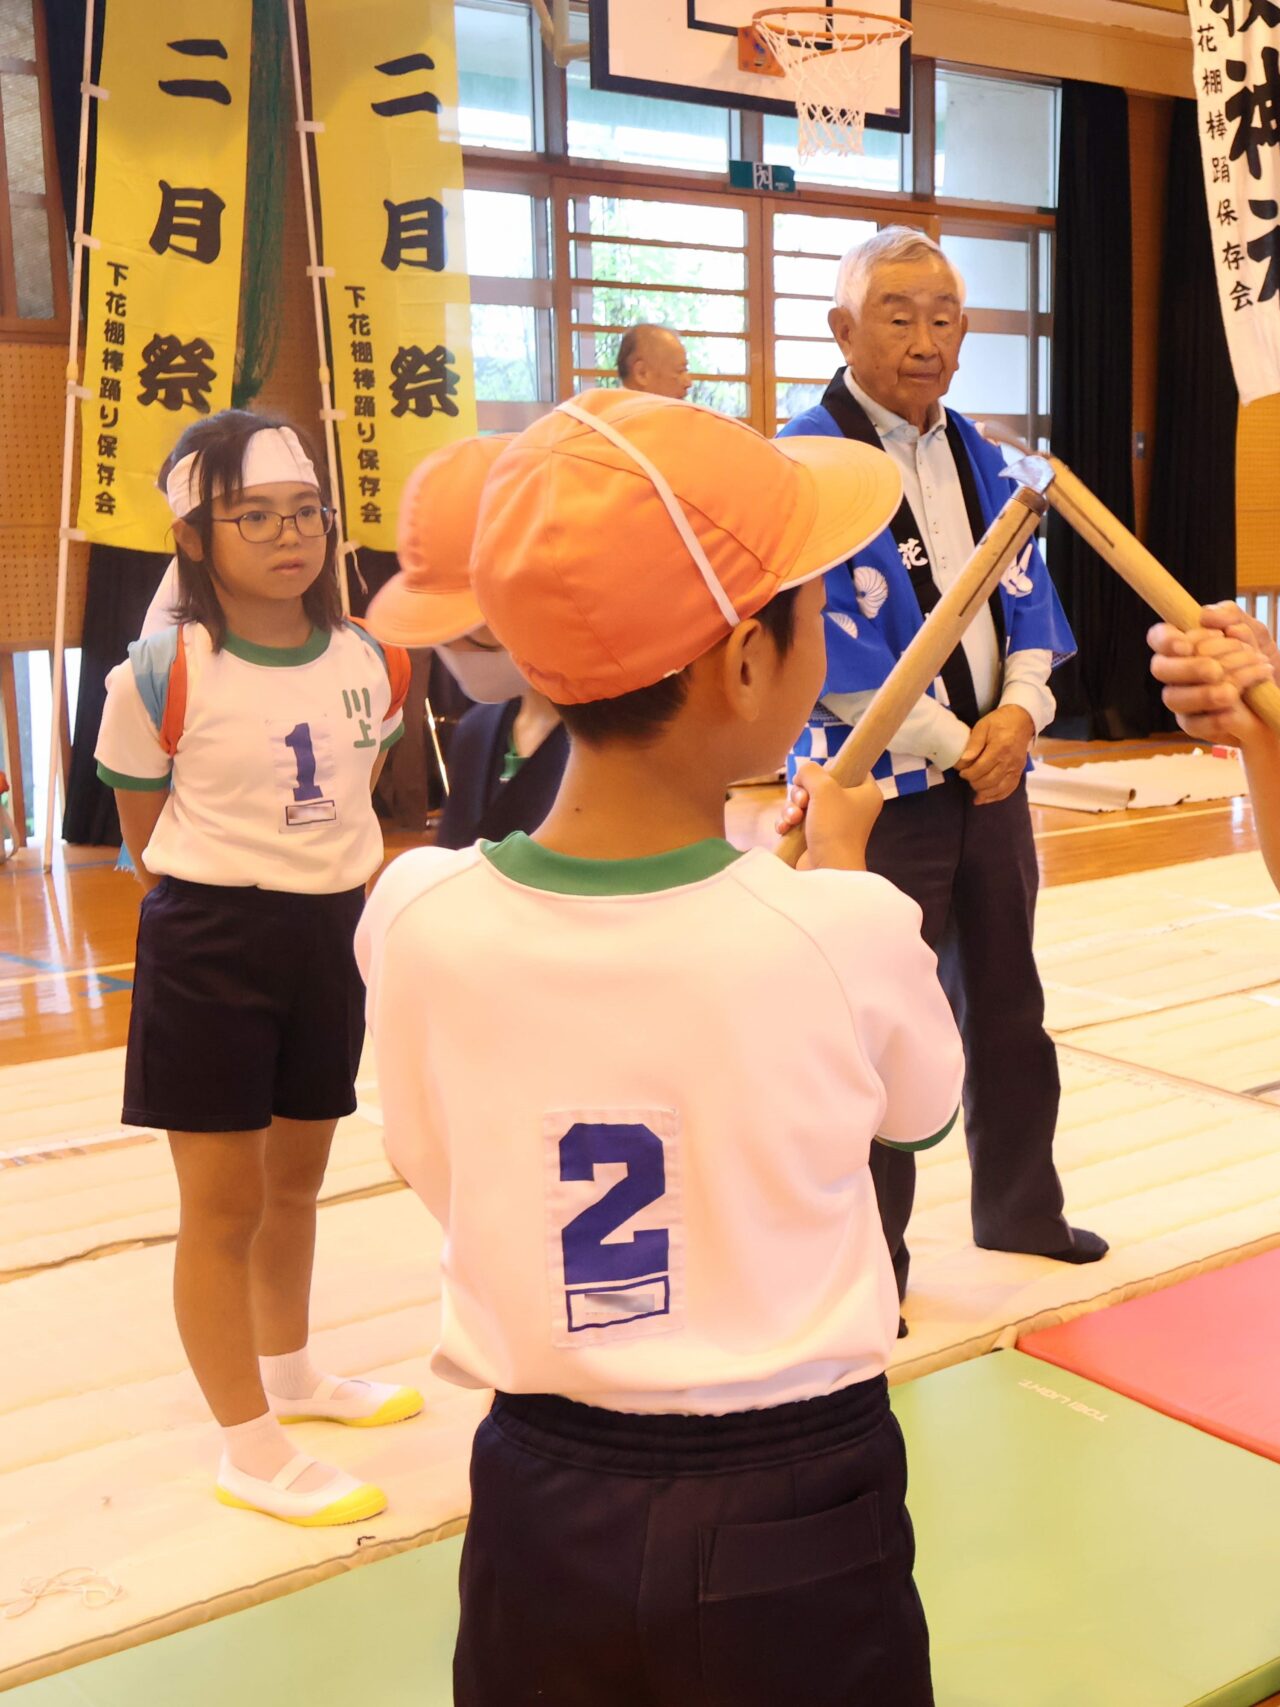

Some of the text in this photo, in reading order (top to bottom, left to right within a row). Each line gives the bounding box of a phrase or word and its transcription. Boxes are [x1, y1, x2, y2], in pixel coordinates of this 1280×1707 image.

[137, 39, 232, 414] 二月祭
[371, 53, 460, 418] 二月祭
[1196, 0, 1254, 312] 花棚棒踊保存会
[95, 261, 129, 516] 下花棚棒踊り保存会
[344, 285, 382, 524] 下花棚棒踊り保存会
[285, 722, 323, 802] 1
[342, 687, 377, 749] 川上
[559, 1123, 669, 1285] 2
